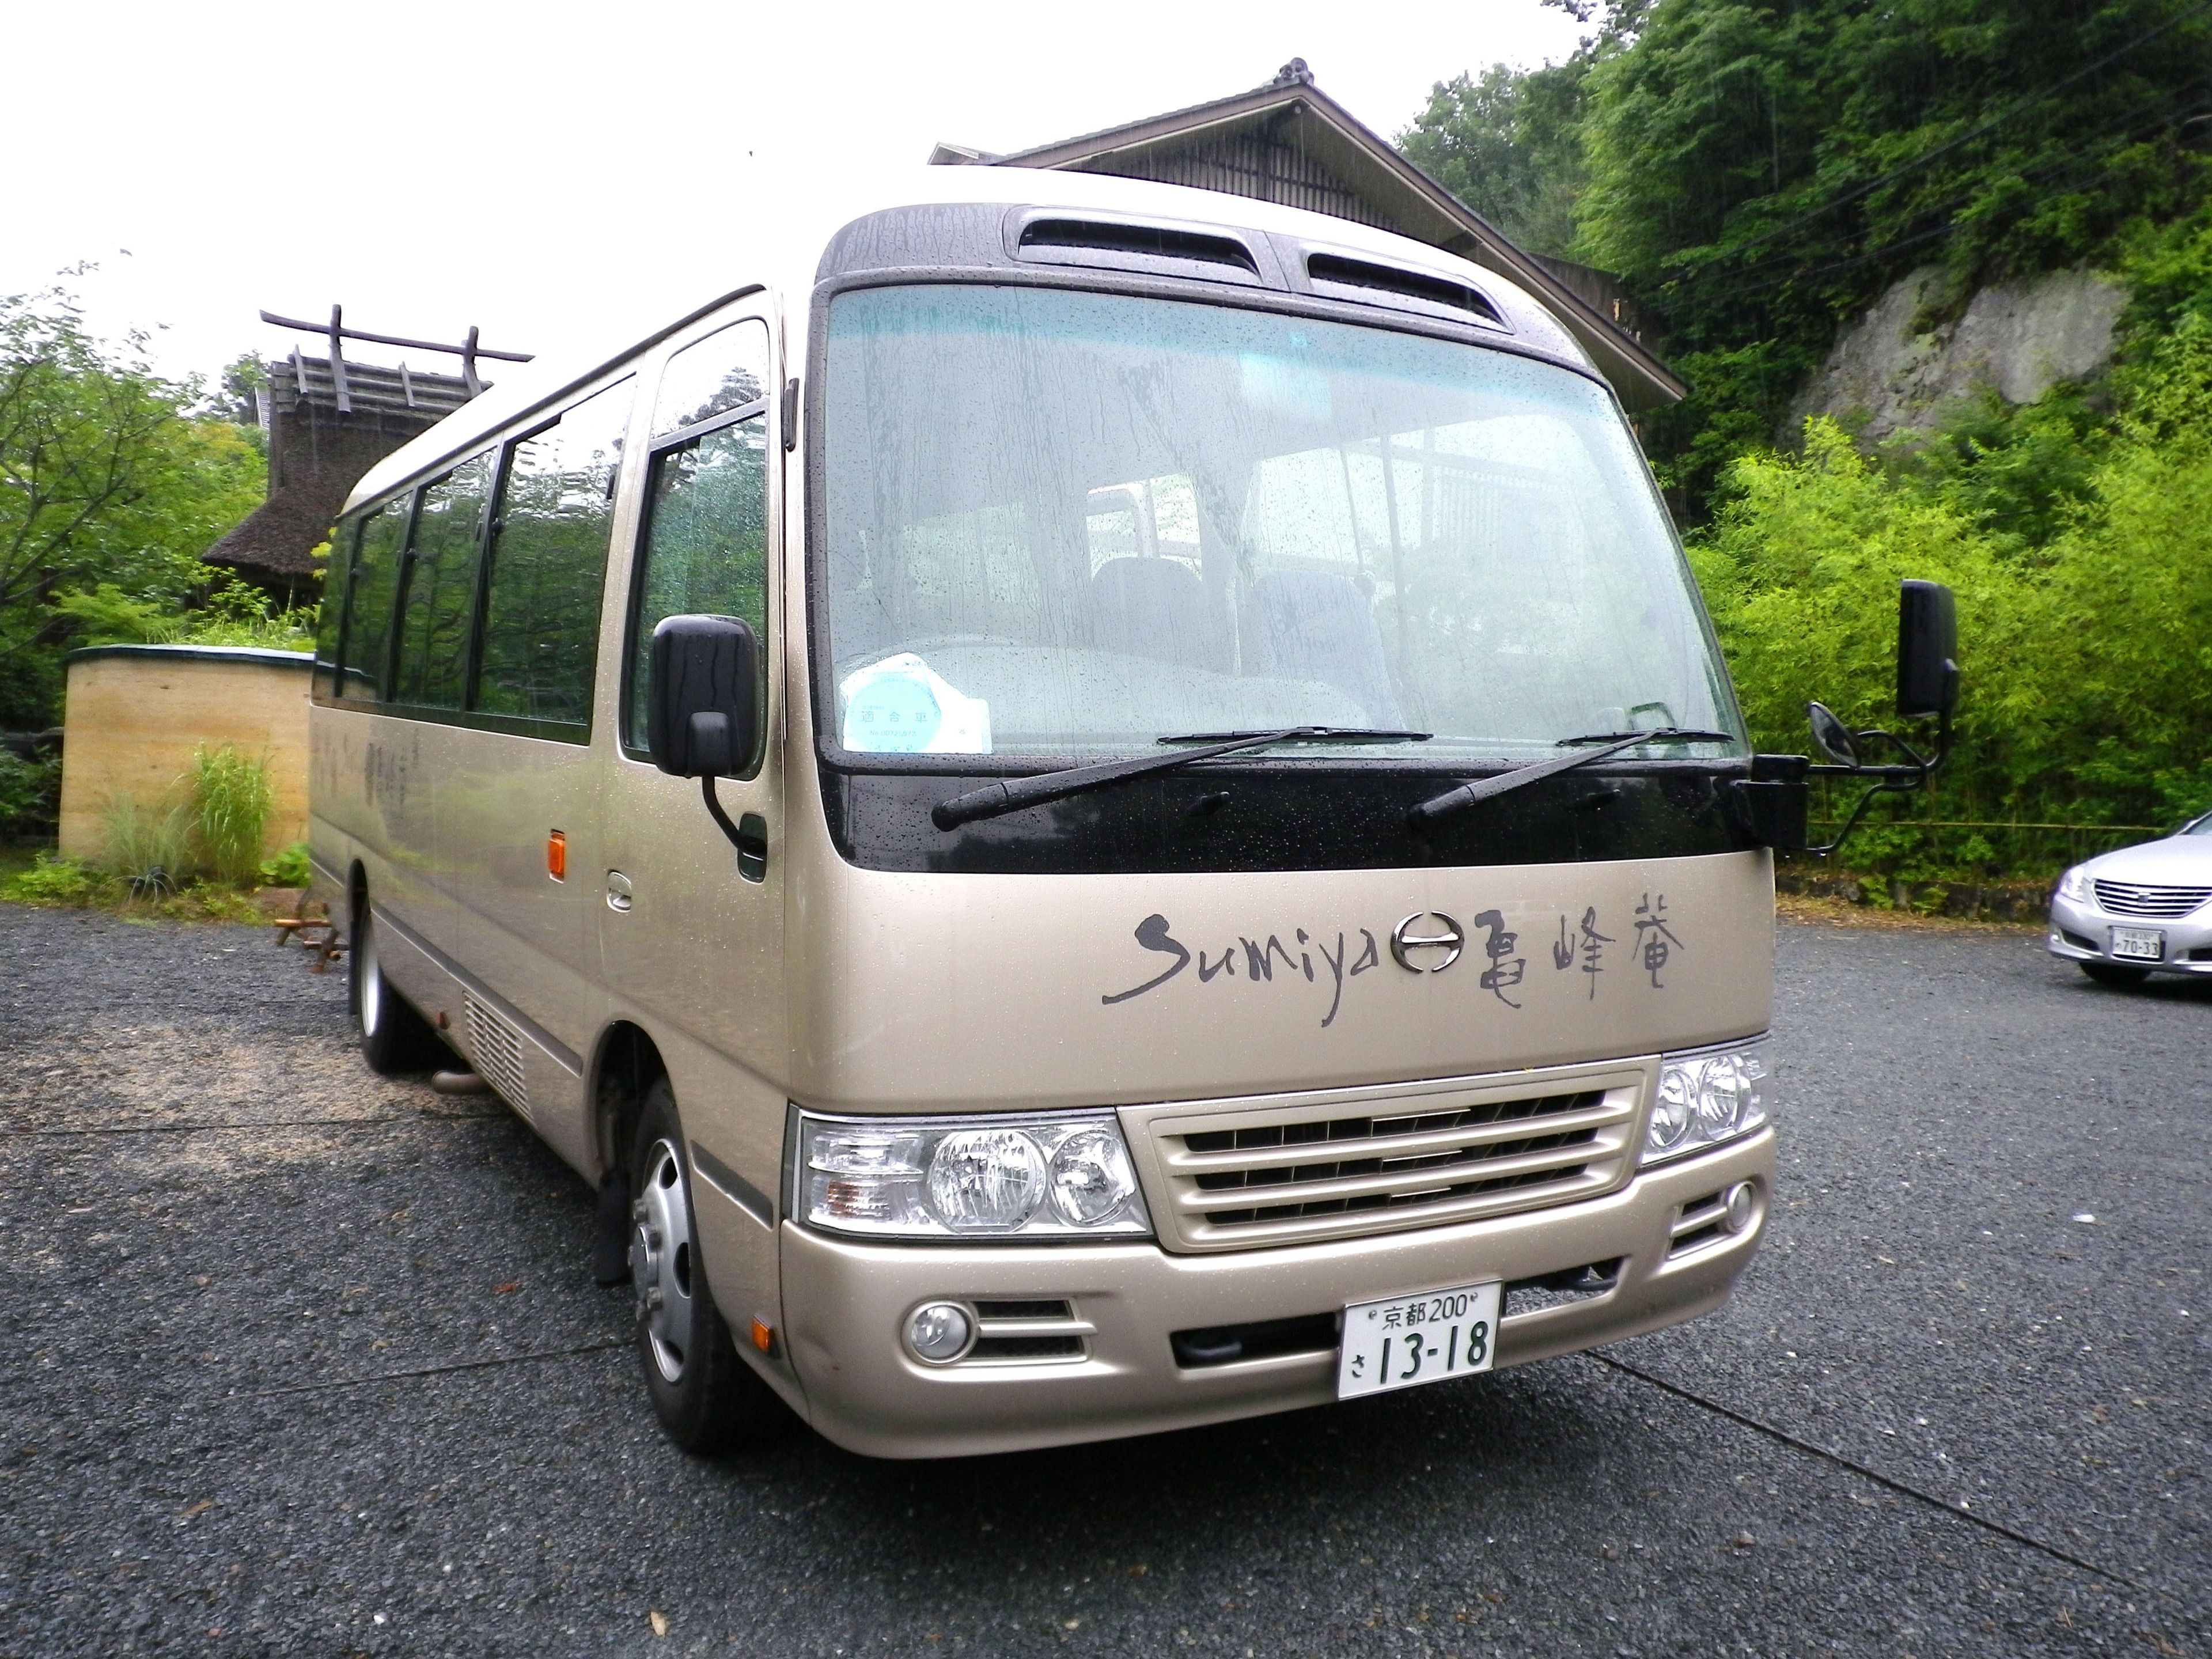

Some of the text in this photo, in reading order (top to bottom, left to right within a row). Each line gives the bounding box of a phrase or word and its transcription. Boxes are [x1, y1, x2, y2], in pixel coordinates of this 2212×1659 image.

[1102, 914, 1379, 1028] Sumiya
[1351, 1321, 1488, 1384] さ 13-18
